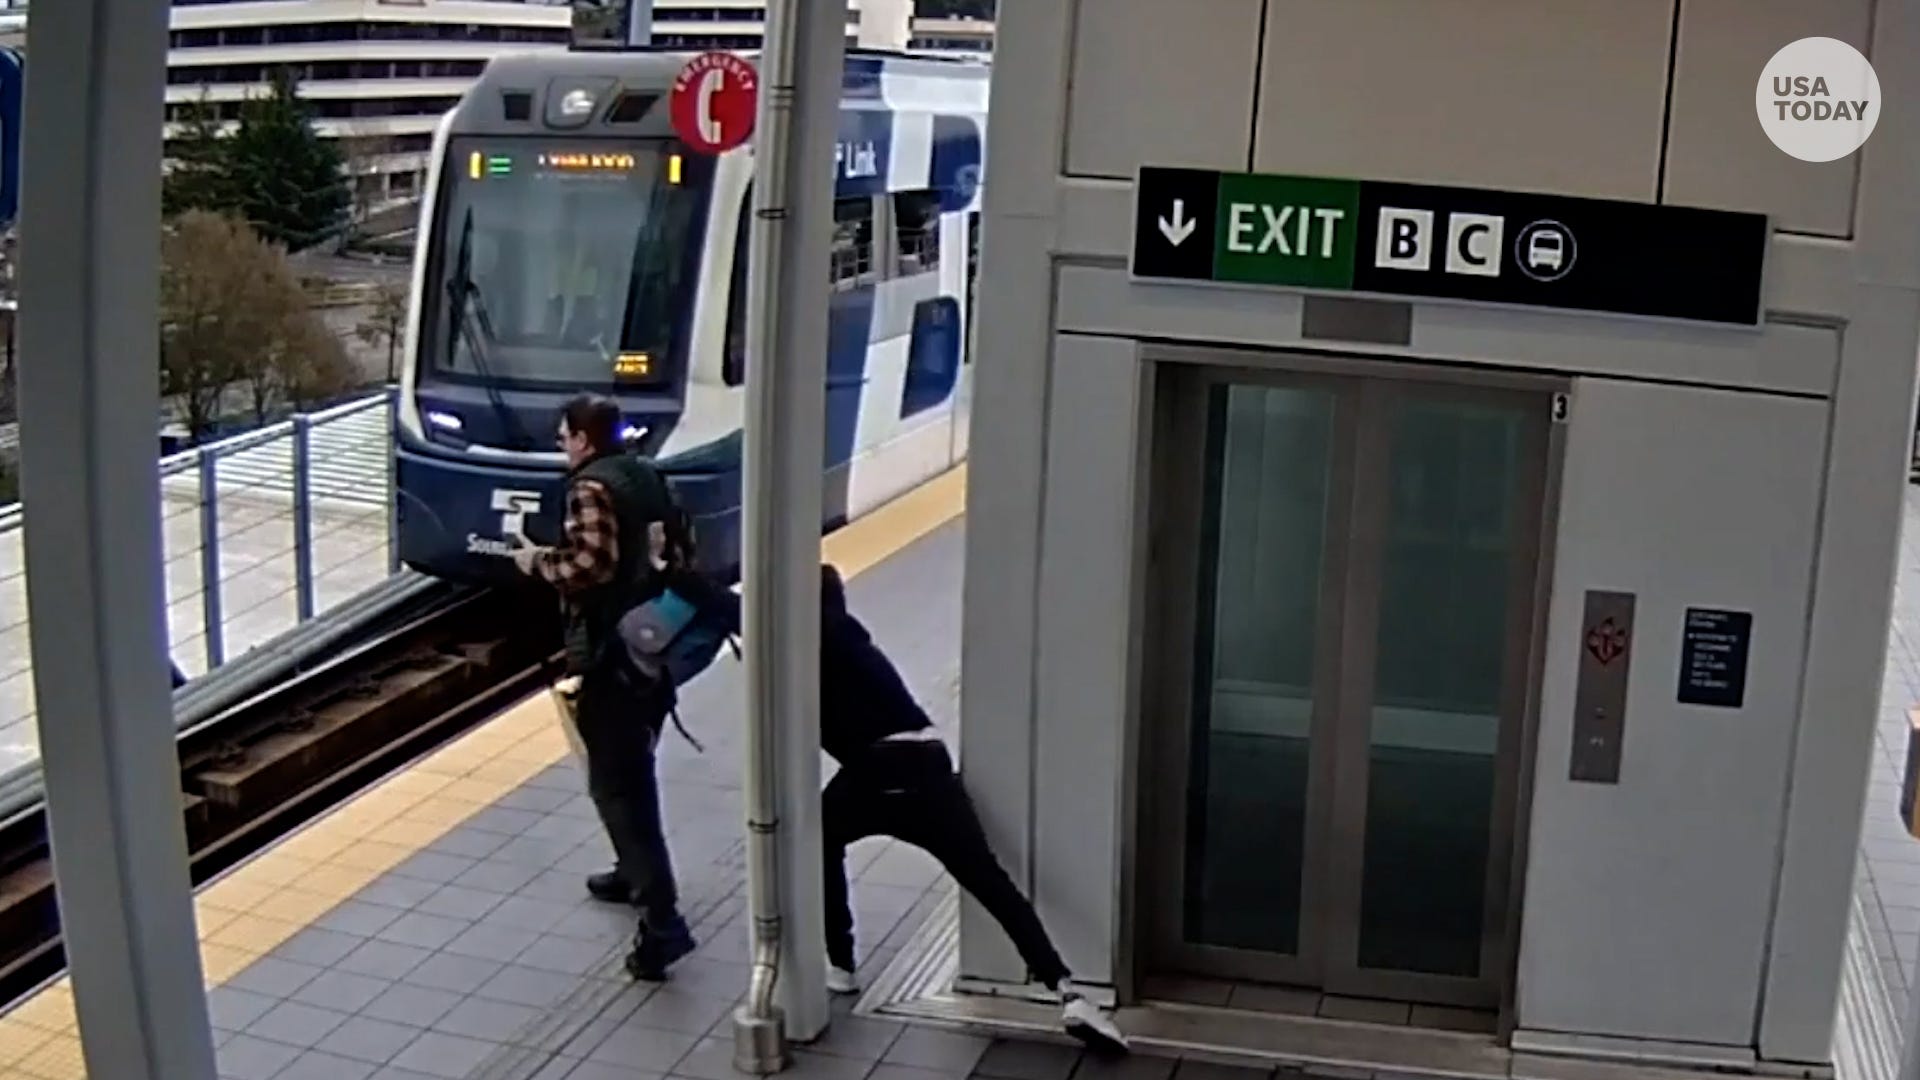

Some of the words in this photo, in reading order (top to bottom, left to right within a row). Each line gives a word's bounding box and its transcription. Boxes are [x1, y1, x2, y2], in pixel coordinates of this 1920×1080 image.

[846, 140, 877, 178] Link
[1228, 203, 1345, 258] EXIT
[1391, 218, 1418, 258] B
[1458, 223, 1490, 265] C
[1557, 396, 1567, 420] 3
